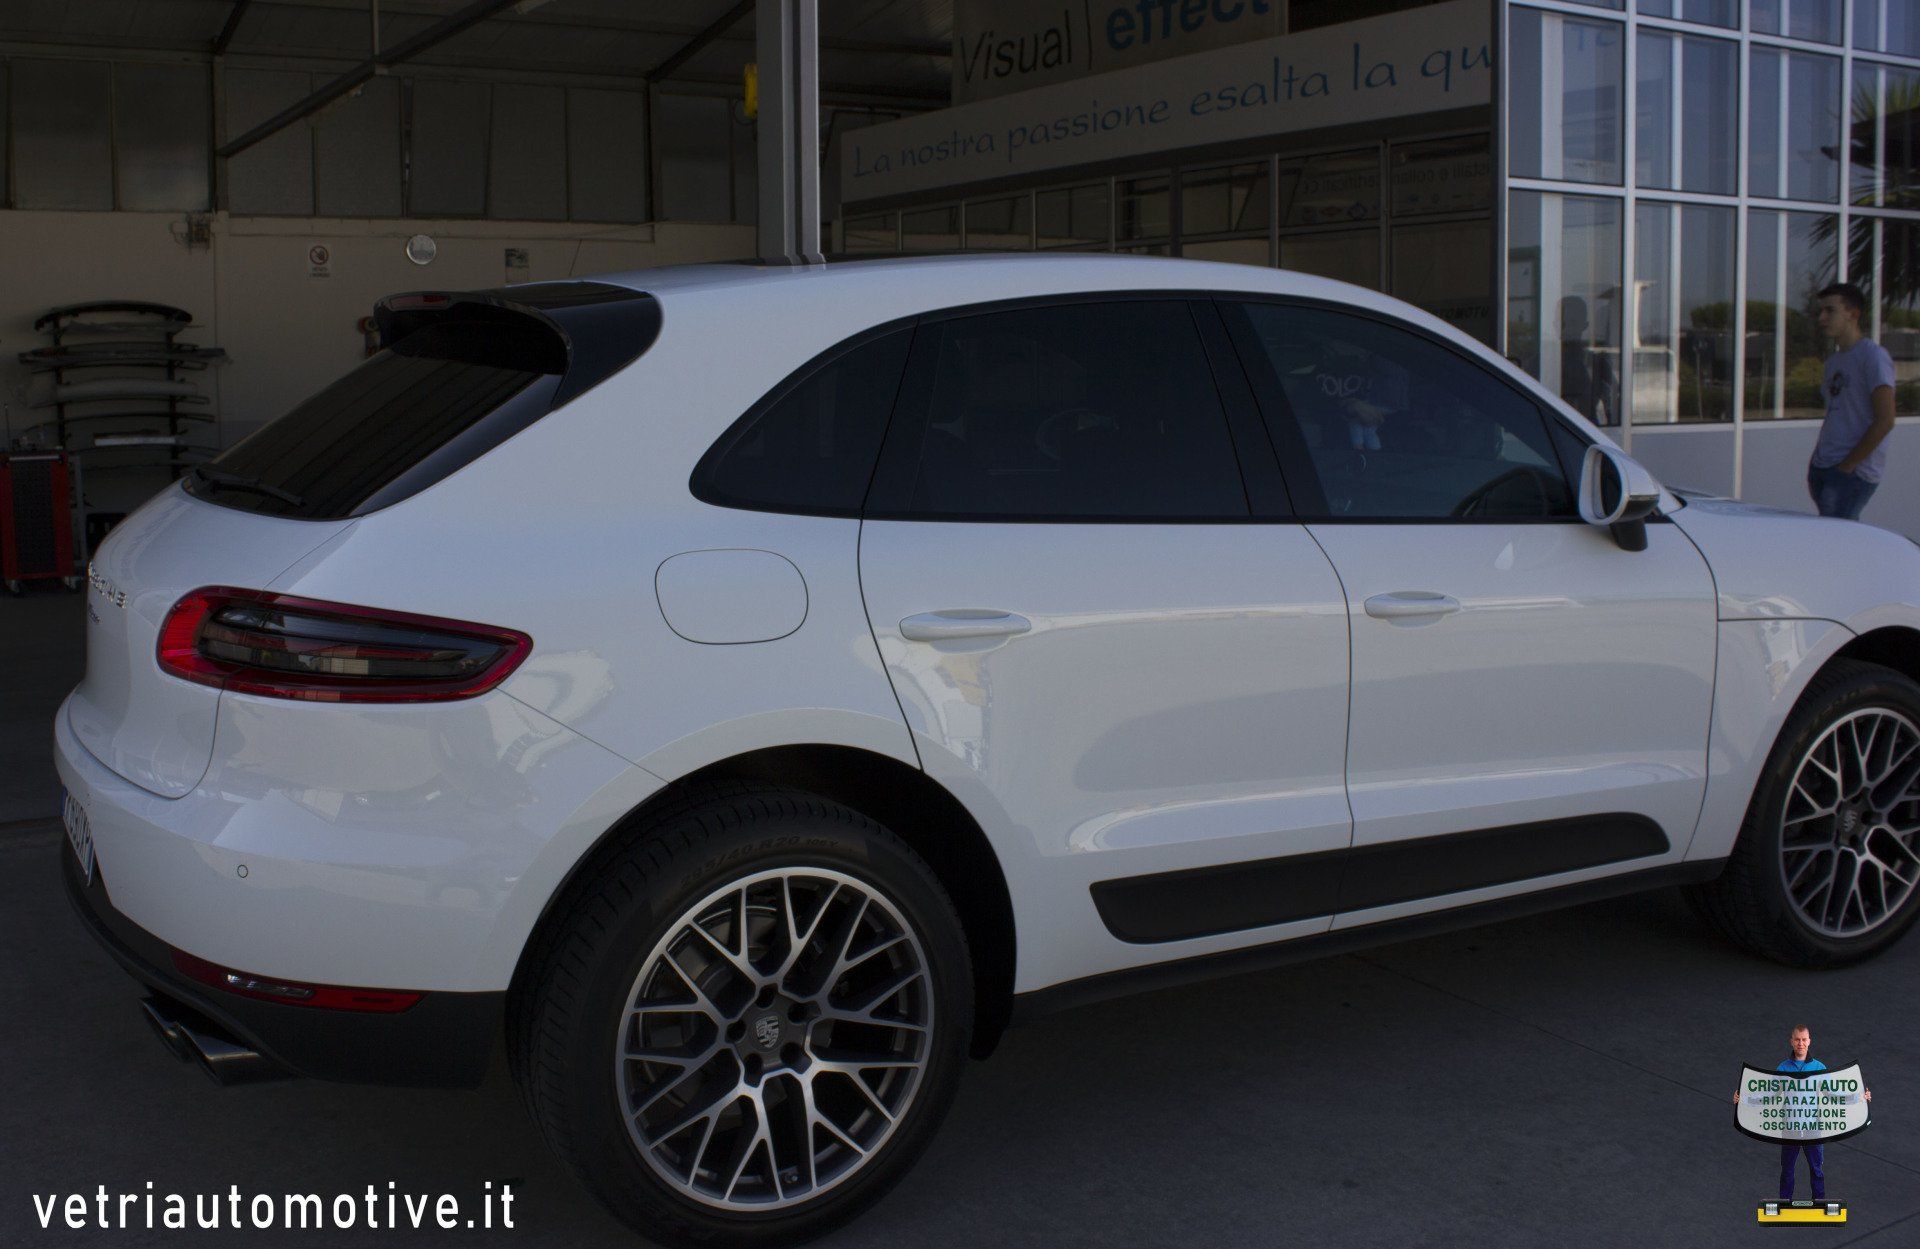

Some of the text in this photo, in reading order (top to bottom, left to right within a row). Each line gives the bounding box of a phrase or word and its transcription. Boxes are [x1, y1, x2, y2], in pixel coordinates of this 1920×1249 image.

[960, 0, 1271, 84] Visual effec
[853, 145, 891, 178] La
[901, 130, 995, 166] nostra
[1007, 99, 1172, 163] passione
[1189, 56, 1331, 117] esalta
[1353, 42, 1397, 91] la
